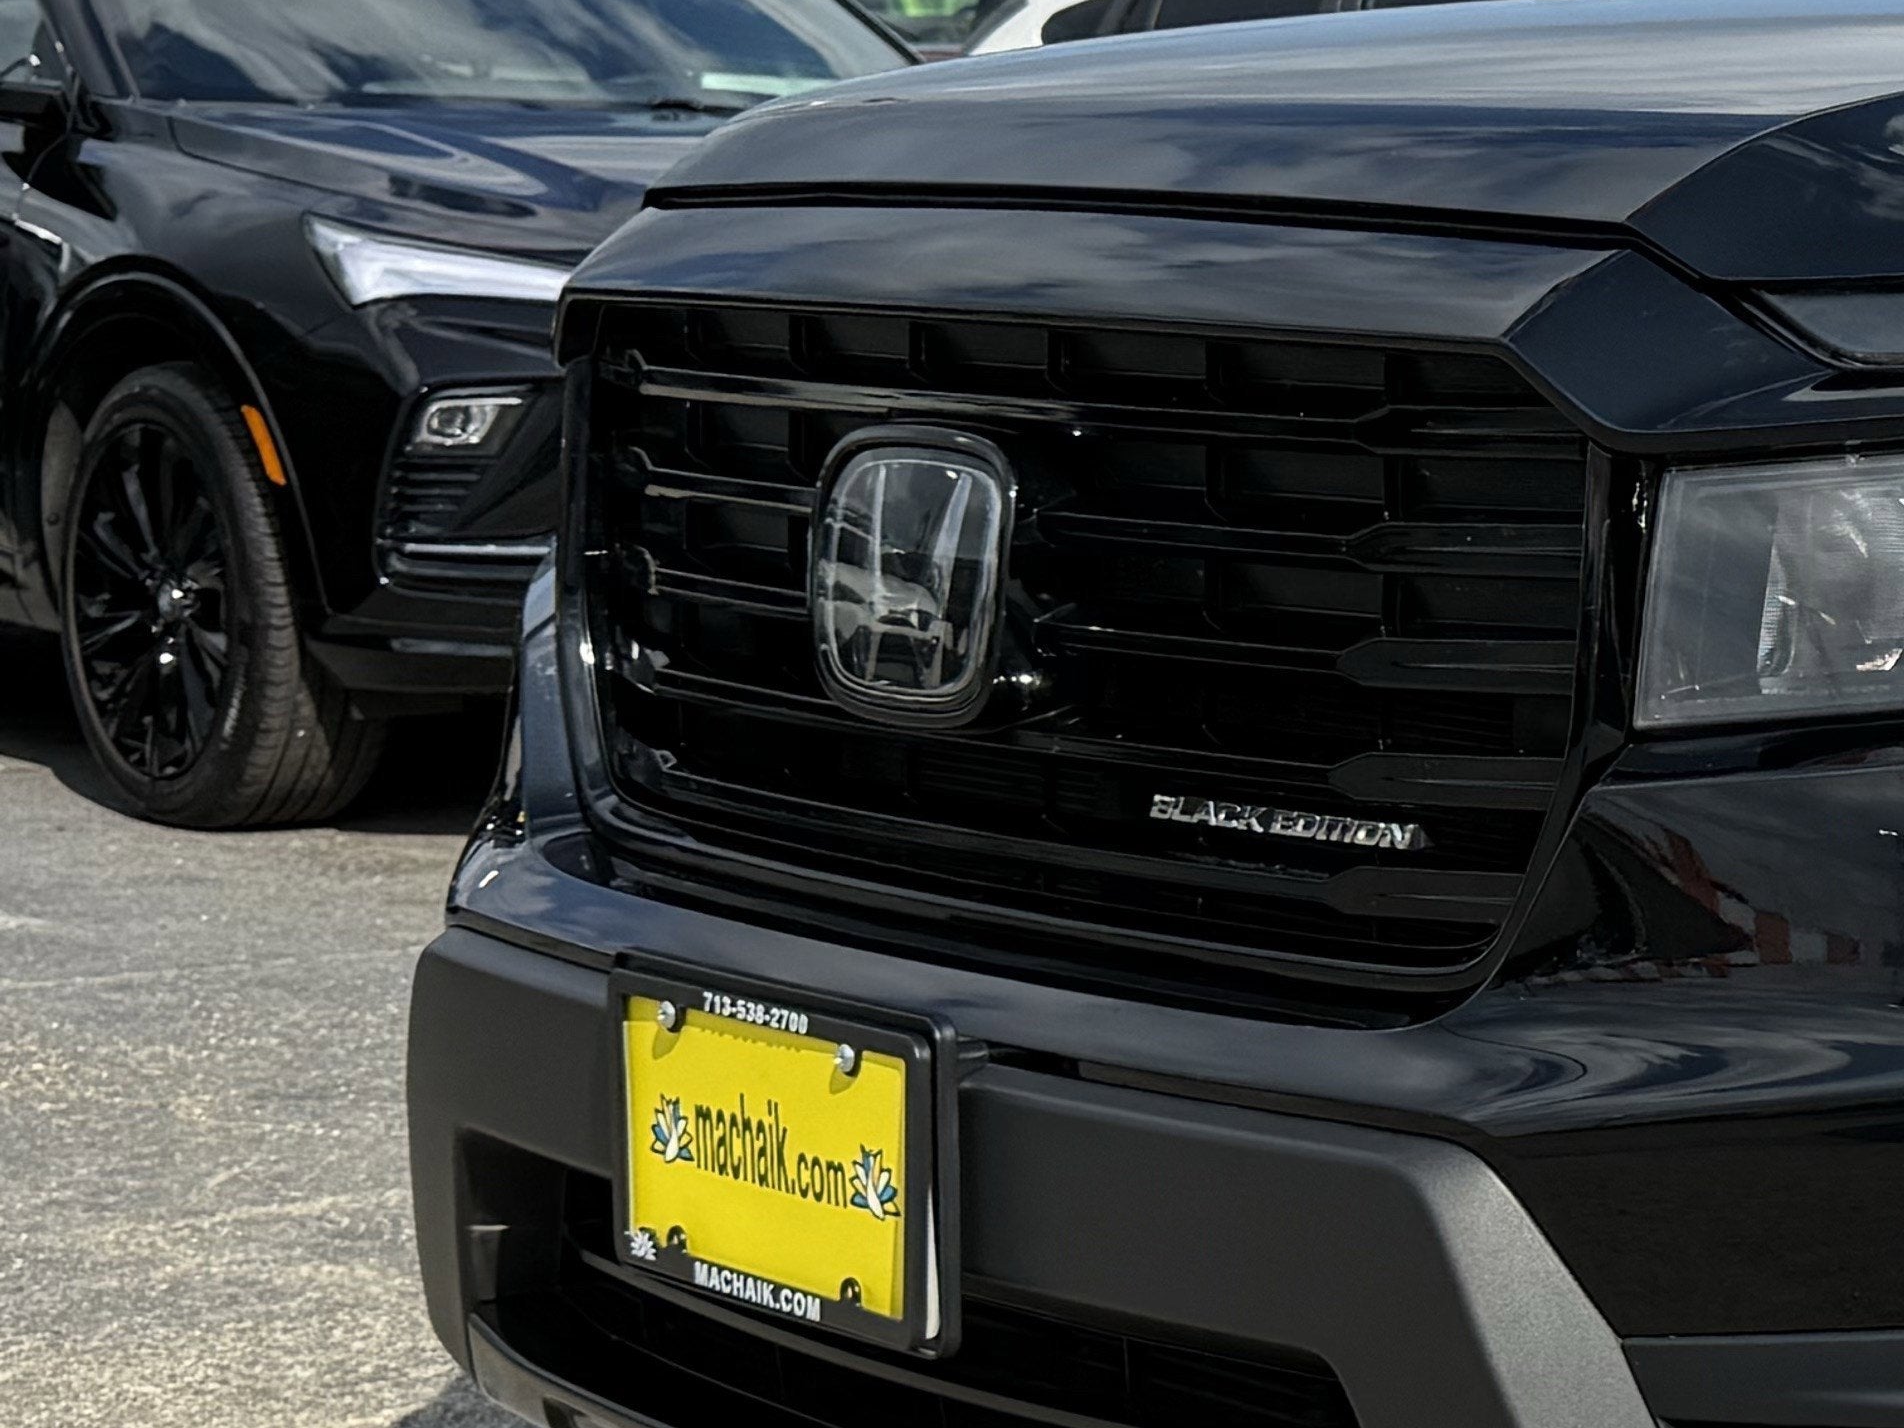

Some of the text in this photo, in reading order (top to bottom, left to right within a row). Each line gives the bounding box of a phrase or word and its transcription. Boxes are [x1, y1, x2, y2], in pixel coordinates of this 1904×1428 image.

[1150, 794, 1420, 851] BLACK EDITION
[694, 1092, 848, 1209] machaik.com
[692, 1260, 822, 1323] MACHAIK.COM
